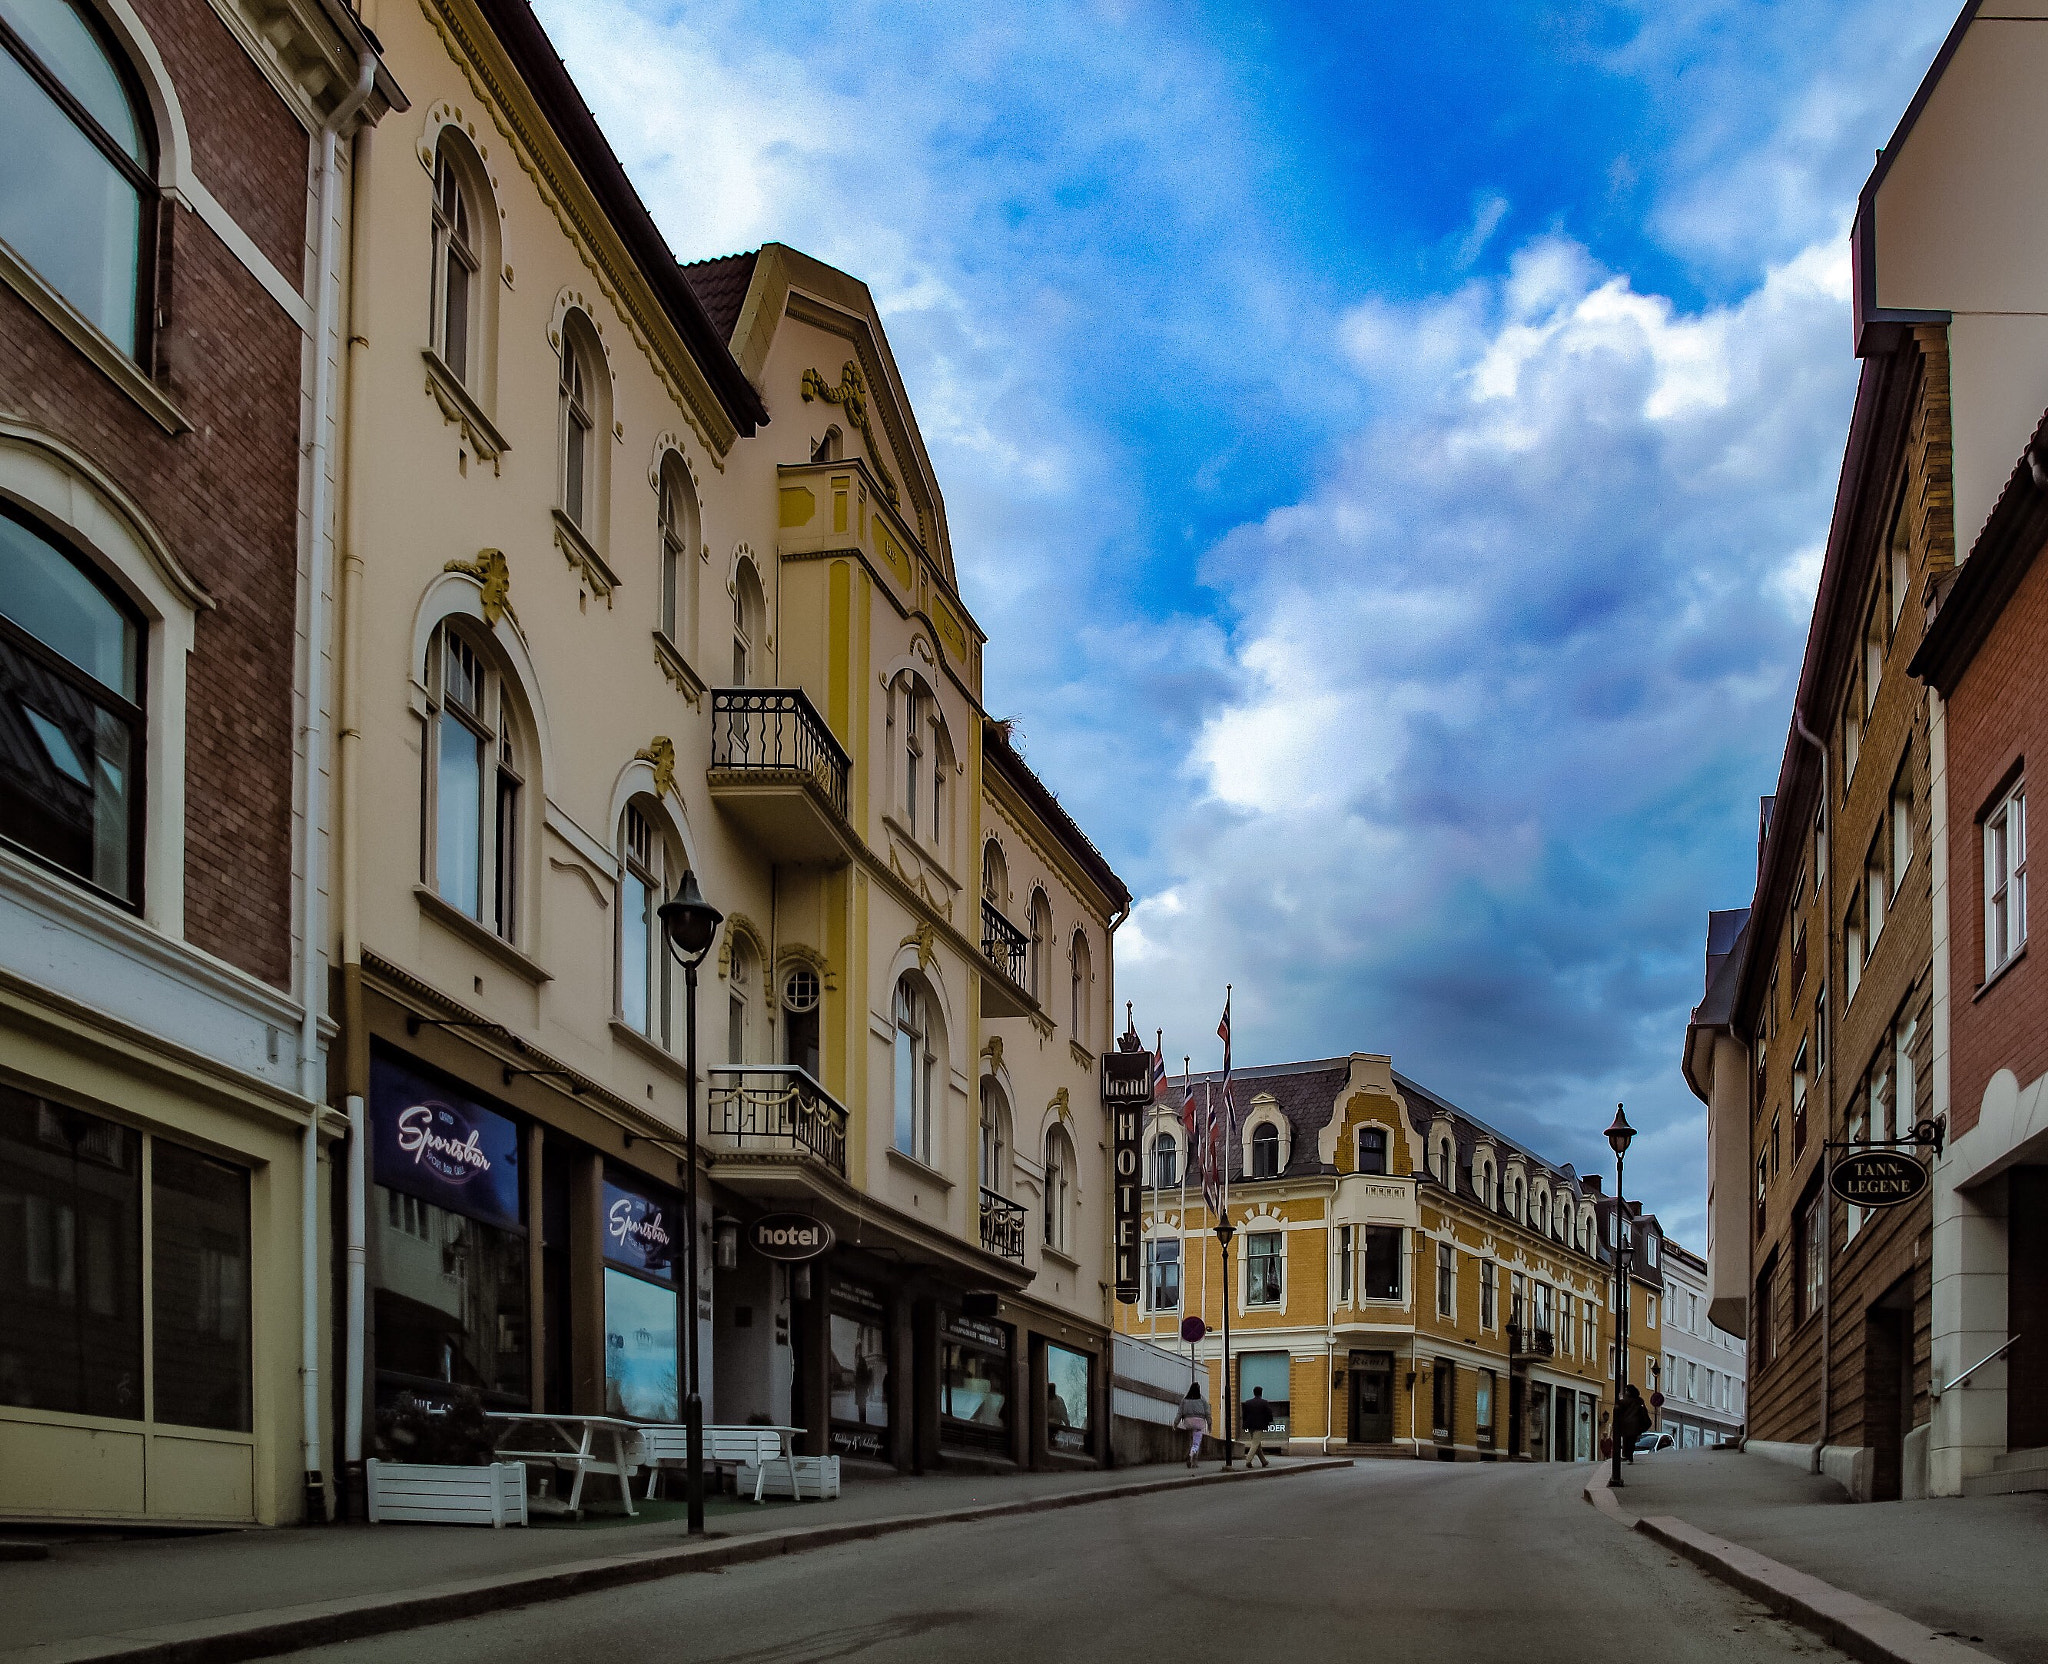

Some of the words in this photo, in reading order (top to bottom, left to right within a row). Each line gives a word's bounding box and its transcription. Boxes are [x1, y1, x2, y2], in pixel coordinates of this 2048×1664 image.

[398, 1105, 491, 1172] Sportsbar
[1848, 1180, 1911, 1193] LEGENE
[1854, 1163, 1903, 1176] TANN-
[1117, 1112, 1136, 1283] HOTEL
[609, 1199, 671, 1248] Sportsbar
[757, 1225, 819, 1246] hotel
